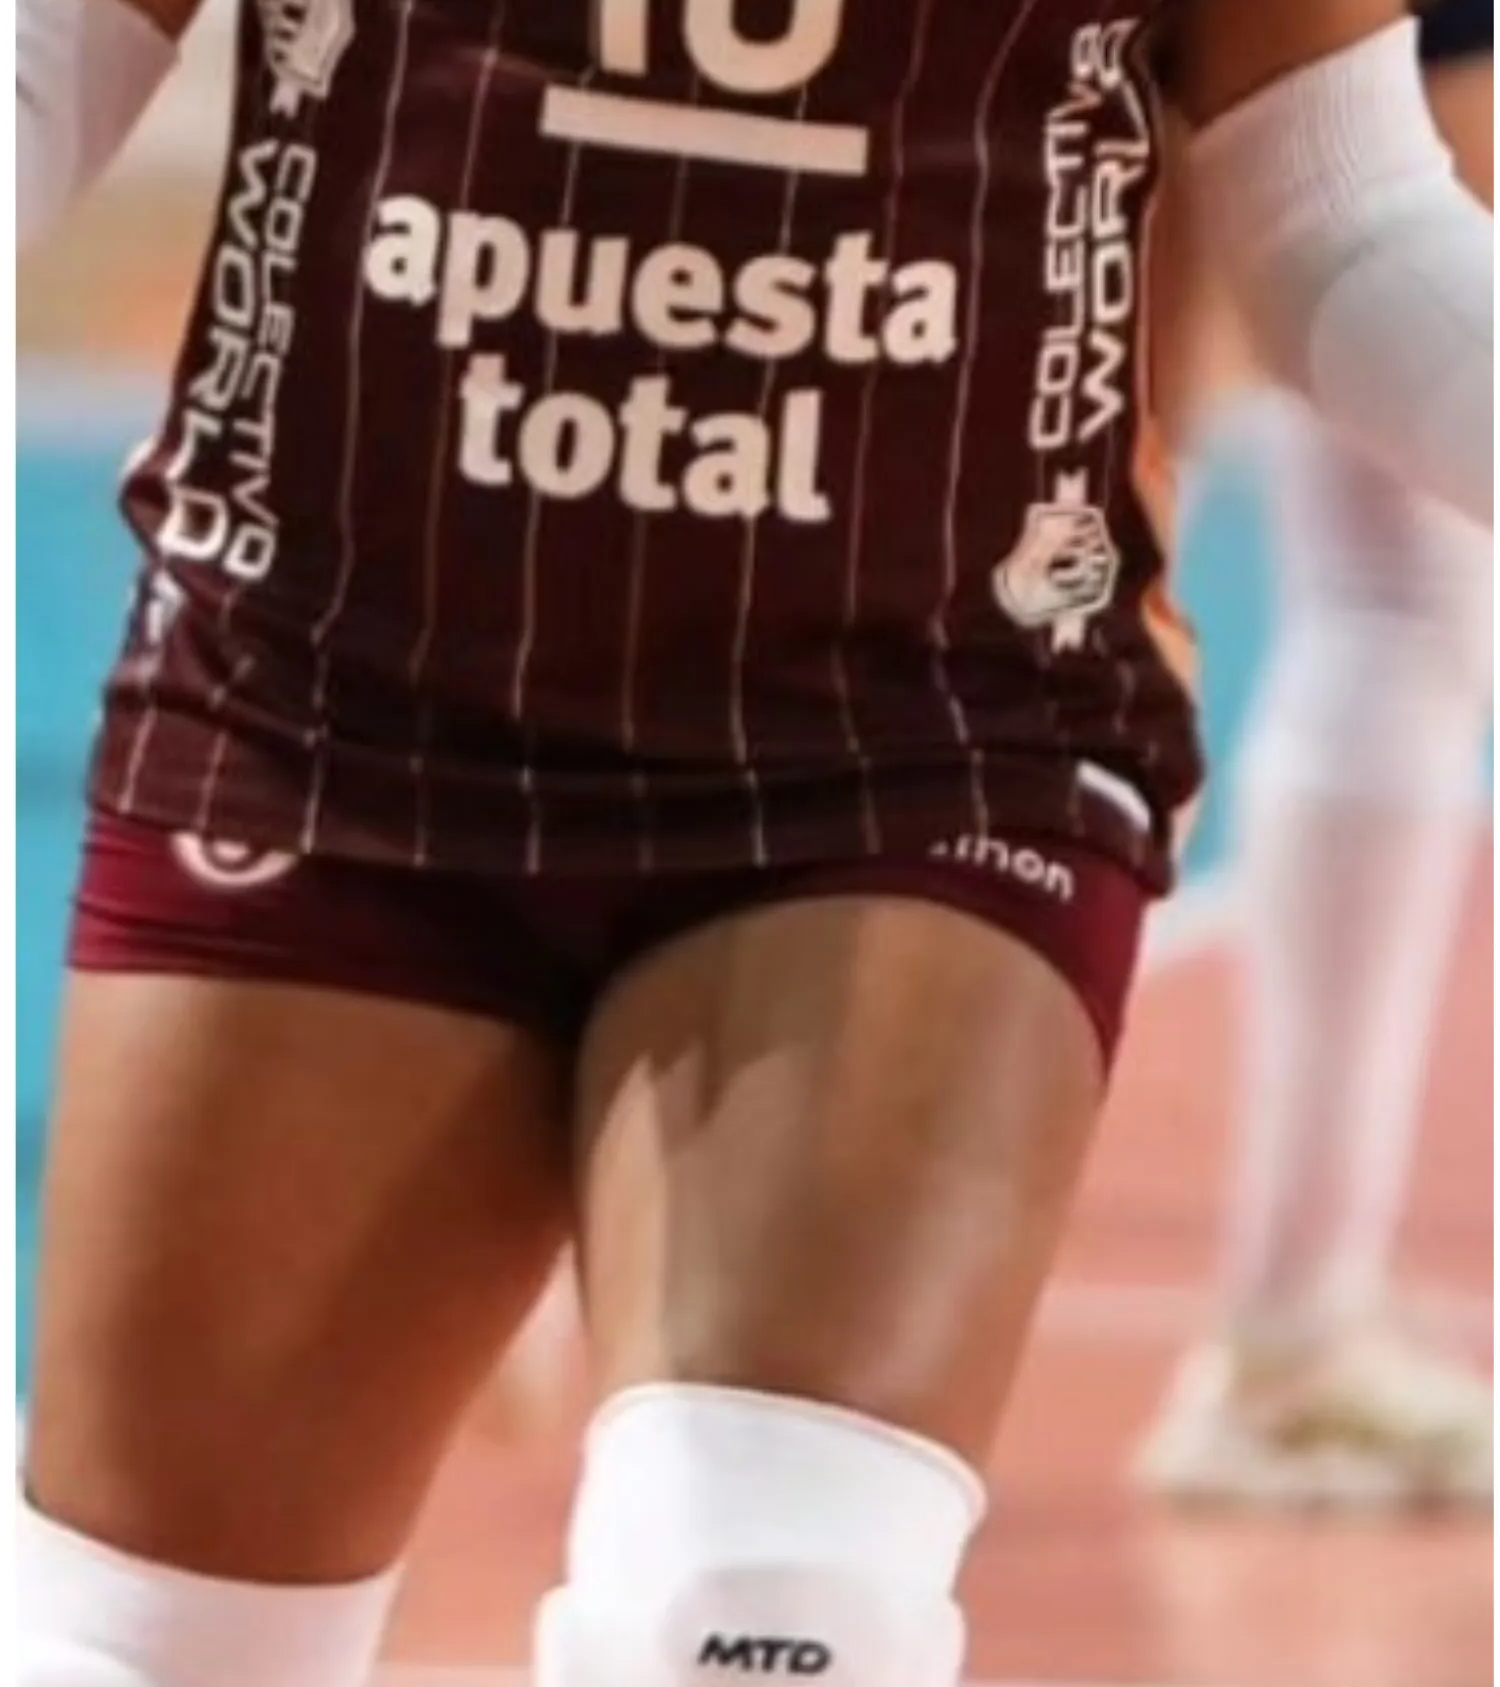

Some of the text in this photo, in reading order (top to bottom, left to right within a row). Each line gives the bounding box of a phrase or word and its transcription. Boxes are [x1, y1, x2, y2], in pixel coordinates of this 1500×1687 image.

[157, 139, 279, 562] WORLD
[223, 142, 318, 582] COLECTIVO
[363, 194, 958, 365] apuesta
[458, 353, 832, 522] total
[1028, 22, 1102, 451] COLECTIVO
[1077, 17, 1151, 443] WORLD
[697, 1631, 833, 1675] MTD
